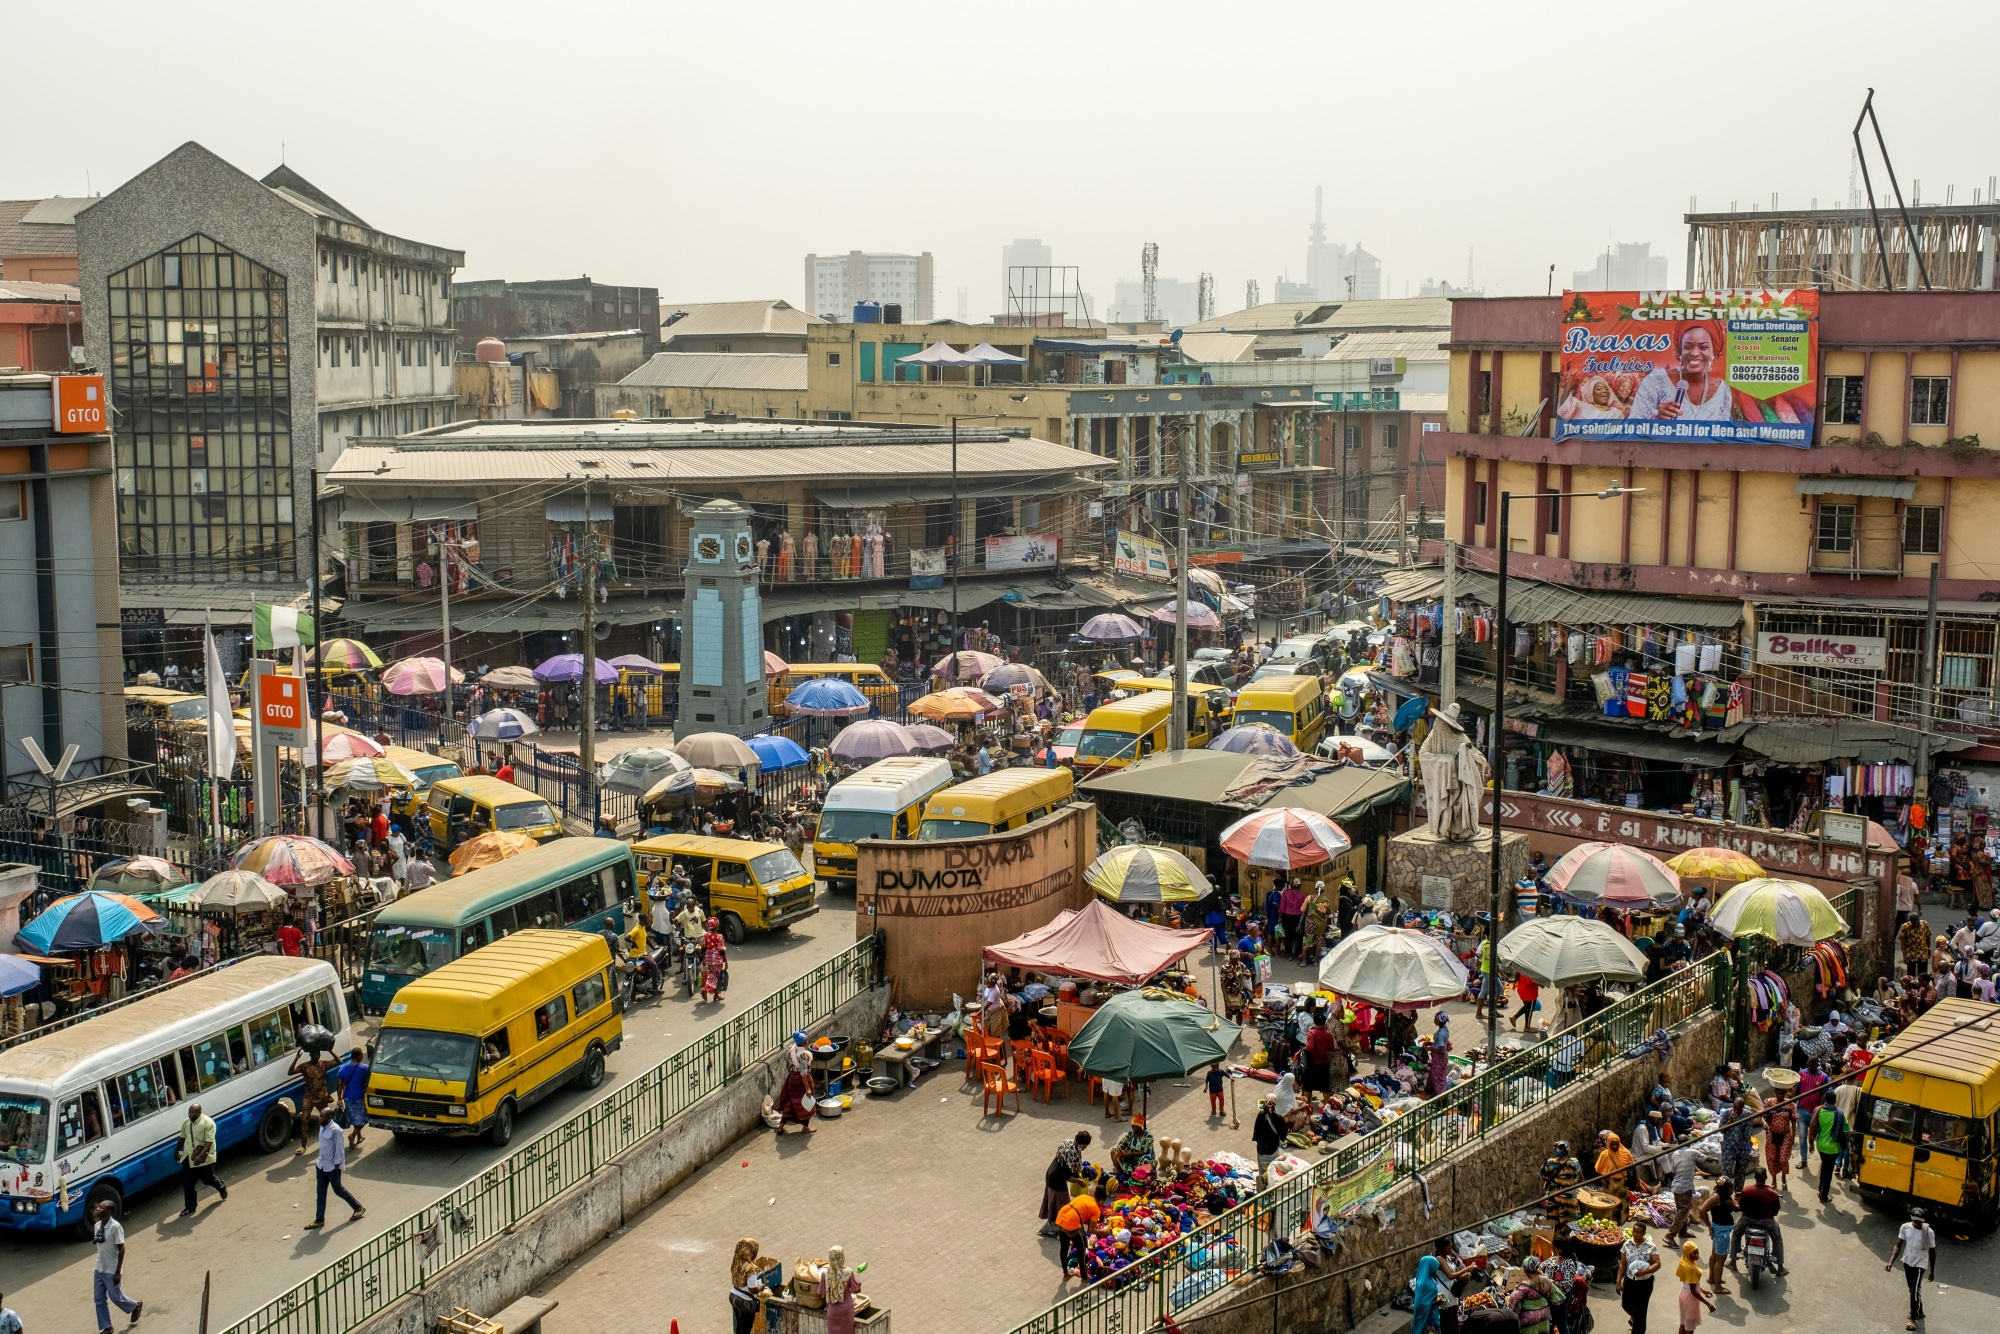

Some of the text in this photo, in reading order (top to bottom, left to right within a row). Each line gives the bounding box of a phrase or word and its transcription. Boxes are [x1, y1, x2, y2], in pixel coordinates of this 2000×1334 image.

[1639, 290, 1795, 305] MERRY
[1631, 307, 1799, 320] CHRISTMAS
[1732, 322, 1804, 332] 43 Martins Street Lagos
[1563, 326, 1671, 353] Brasas
[1771, 335, 1800, 343] Senator
[1583, 354, 1653, 372] Fabrics
[1732, 373, 1799, 381] 08090785000
[68, 408, 100, 423] GTCO
[1563, 422, 1805, 440] The solution to all Aso-Ebi for Men and Women
[1116, 557, 1139, 572] POS
[1011, 683, 1027, 693] POS
[266, 703, 294, 719] GTCO
[945, 840, 1034, 869] IDUMOTA
[1715, 872, 1736, 880] MAGGI
